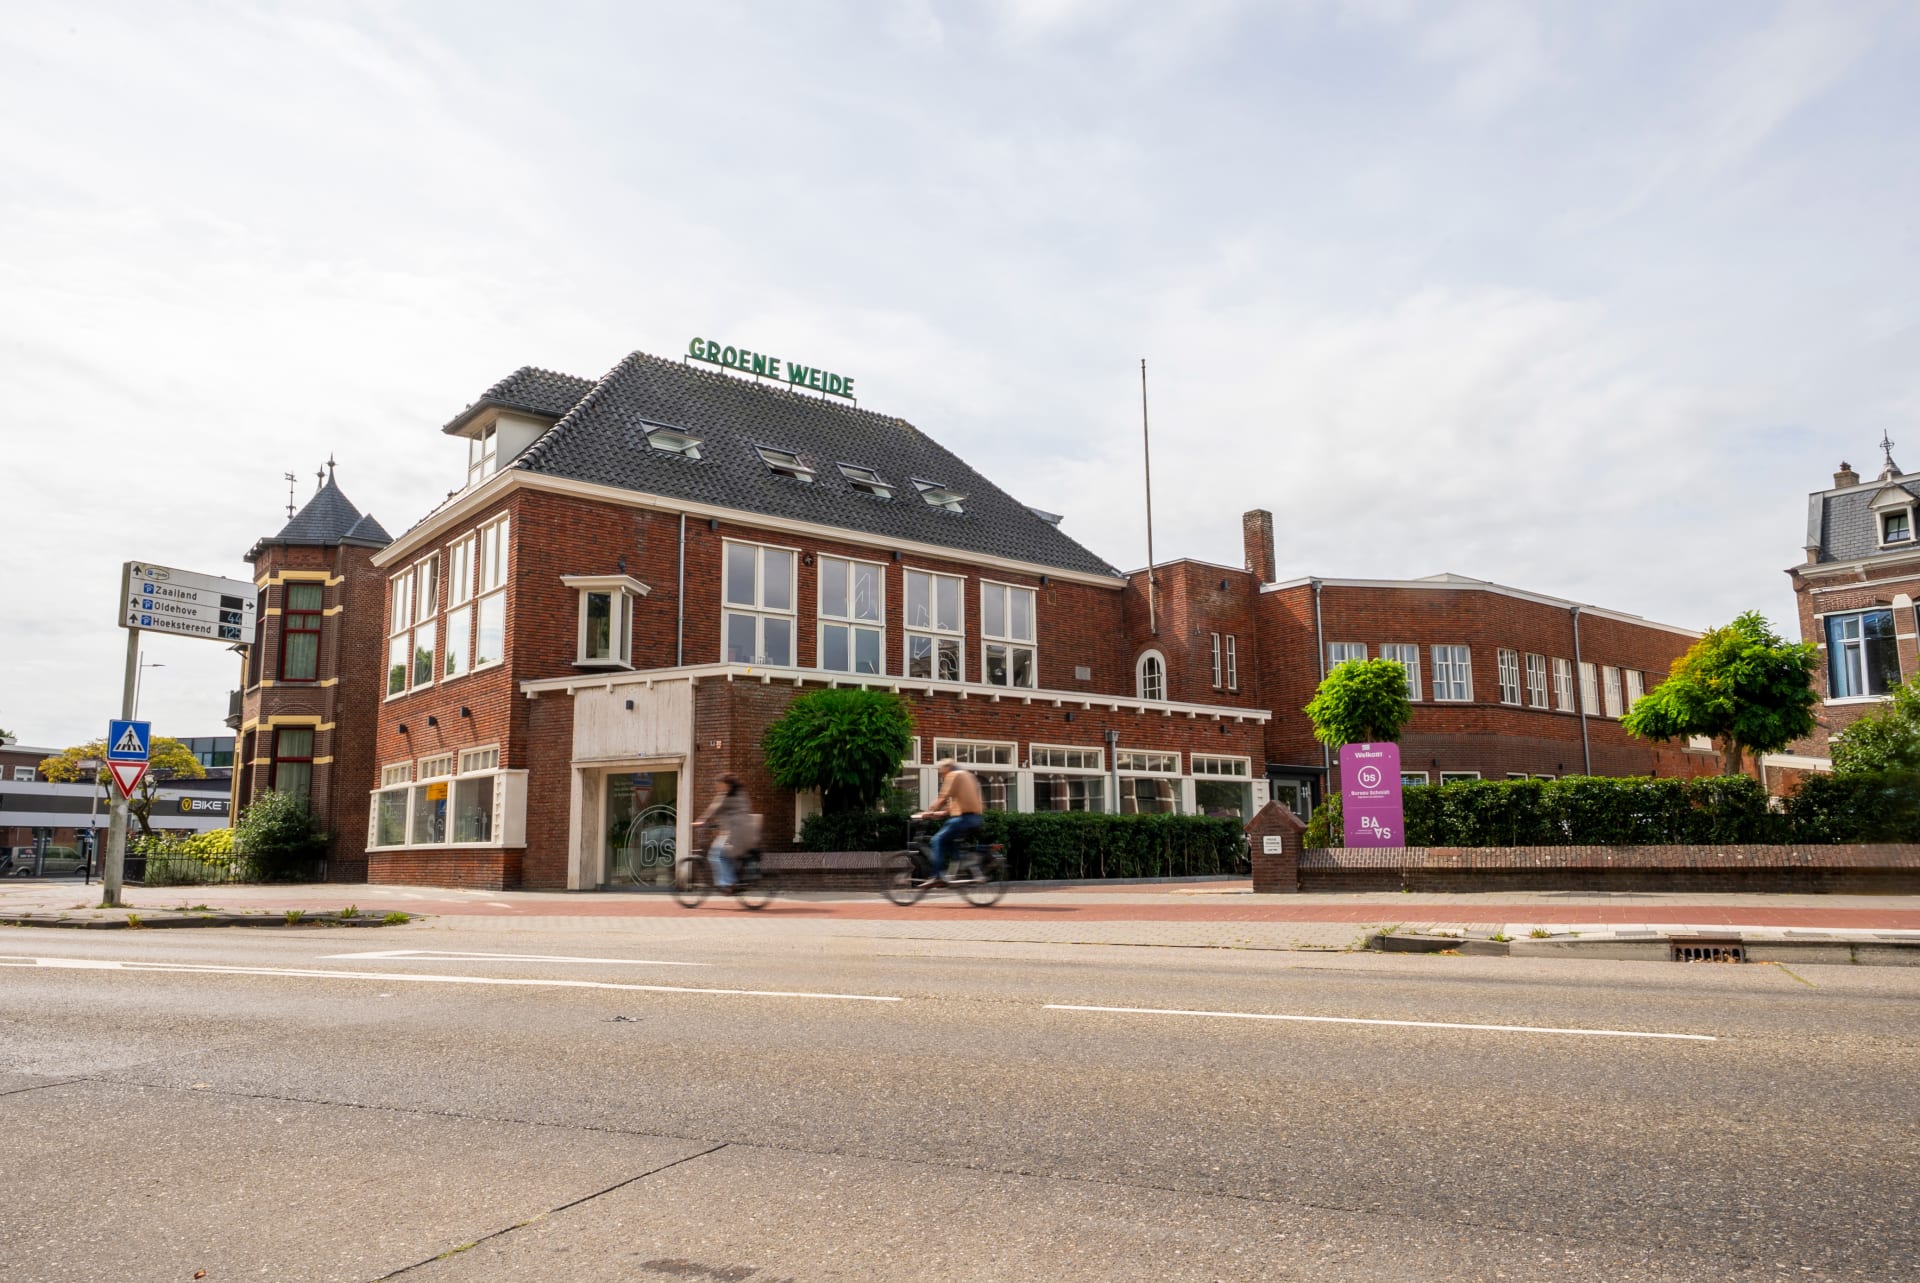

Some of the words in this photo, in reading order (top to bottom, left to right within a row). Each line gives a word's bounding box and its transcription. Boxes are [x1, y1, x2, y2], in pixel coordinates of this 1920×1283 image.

[689, 337, 781, 379] GROENE
[787, 362, 855, 397] WEIDE
[155, 585, 197, 601] Zaailand
[154, 601, 198, 616] Oldehove
[227, 612, 241, 625] 44
[152, 617, 212, 634] Hoeksterend
[223, 626, 241, 640] 125
[1363, 772, 1376, 782] bs
[192, 800, 222, 810] BIKE
[640, 831, 677, 868] bs
